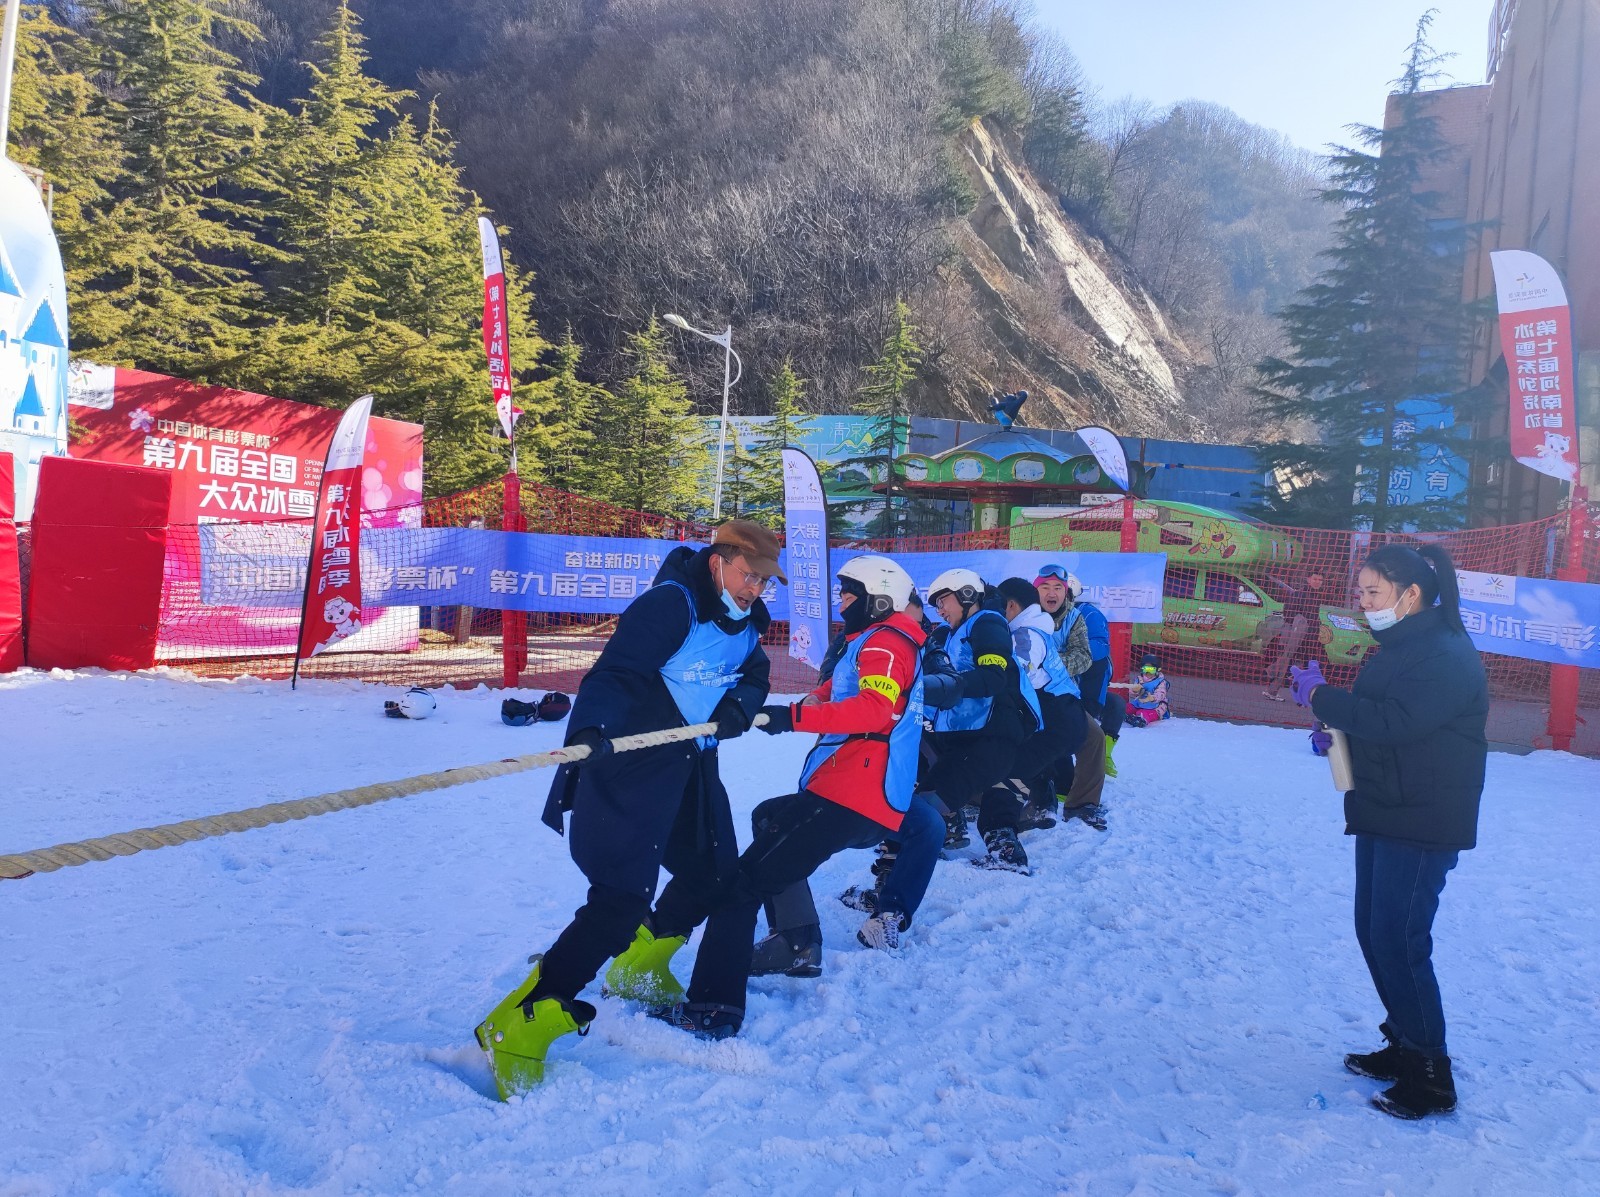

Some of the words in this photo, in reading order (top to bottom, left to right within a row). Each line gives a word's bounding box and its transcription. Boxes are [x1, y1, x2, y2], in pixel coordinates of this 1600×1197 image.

[143, 435, 298, 484] 第九届全国
[199, 479, 319, 518] 大众冰雪
[565, 551, 661, 570] 奋进新时代
[1459, 607, 1600, 650] 国体育彩
[874, 680, 893, 691] VIP
